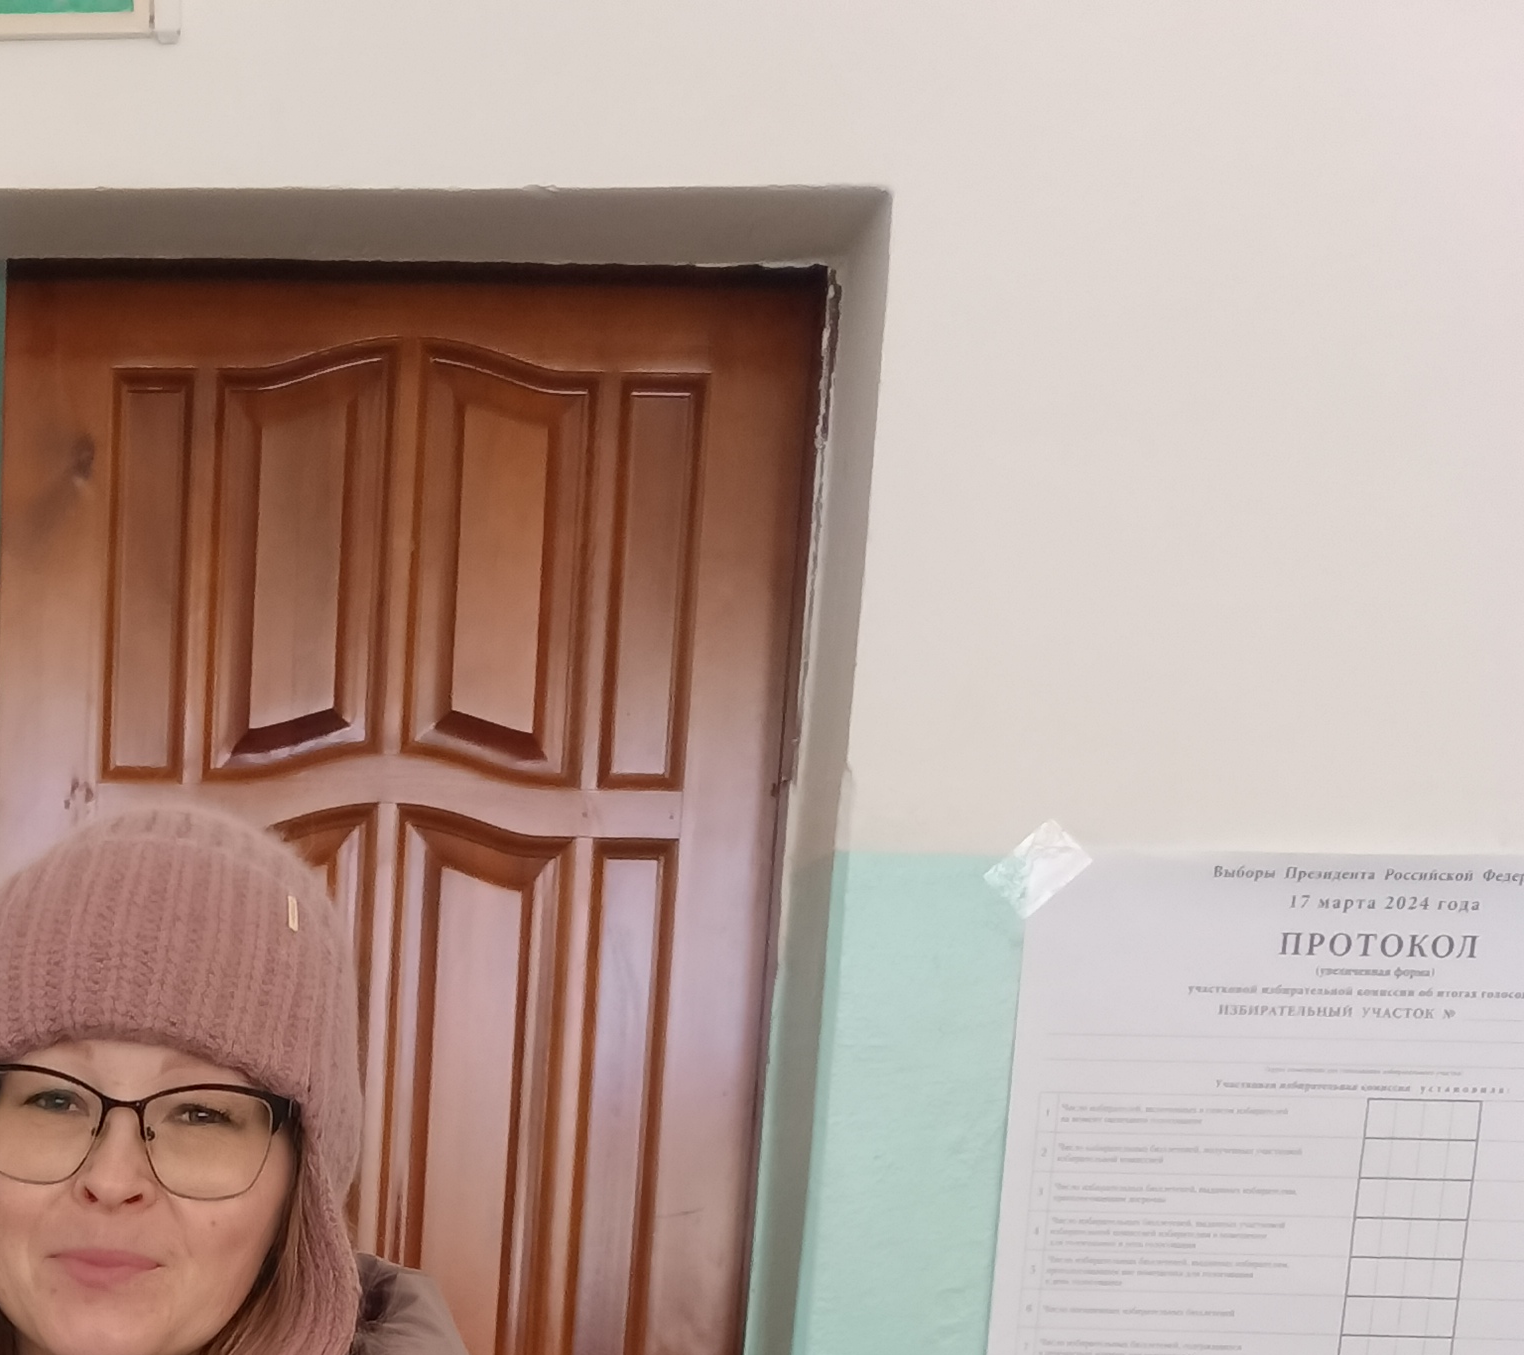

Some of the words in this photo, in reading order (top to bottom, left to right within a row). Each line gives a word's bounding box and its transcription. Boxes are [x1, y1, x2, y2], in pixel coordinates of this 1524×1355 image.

[1213, 865, 1276, 882] Выборы
[1283, 866, 1375, 883] Президента
[1384, 868, 1474, 883] Российской
[1289, 894, 1311, 909] 17
[1317, 897, 1376, 914] марта
[1384, 896, 1430, 911] 2024
[1437, 899, 1481, 914] года
[1278, 931, 1480, 959] ПРОТОКОЛ
[1261, 984, 1353, 997] избирательной
[1418, 986, 1434, 998] об
[1481, 990, 1524, 999] голосо
[1217, 1003, 1354, 1019] ИЗБИРАТЕЛЬНЫЙ
[1361, 1006, 1435, 1020] УЧАСТОК
